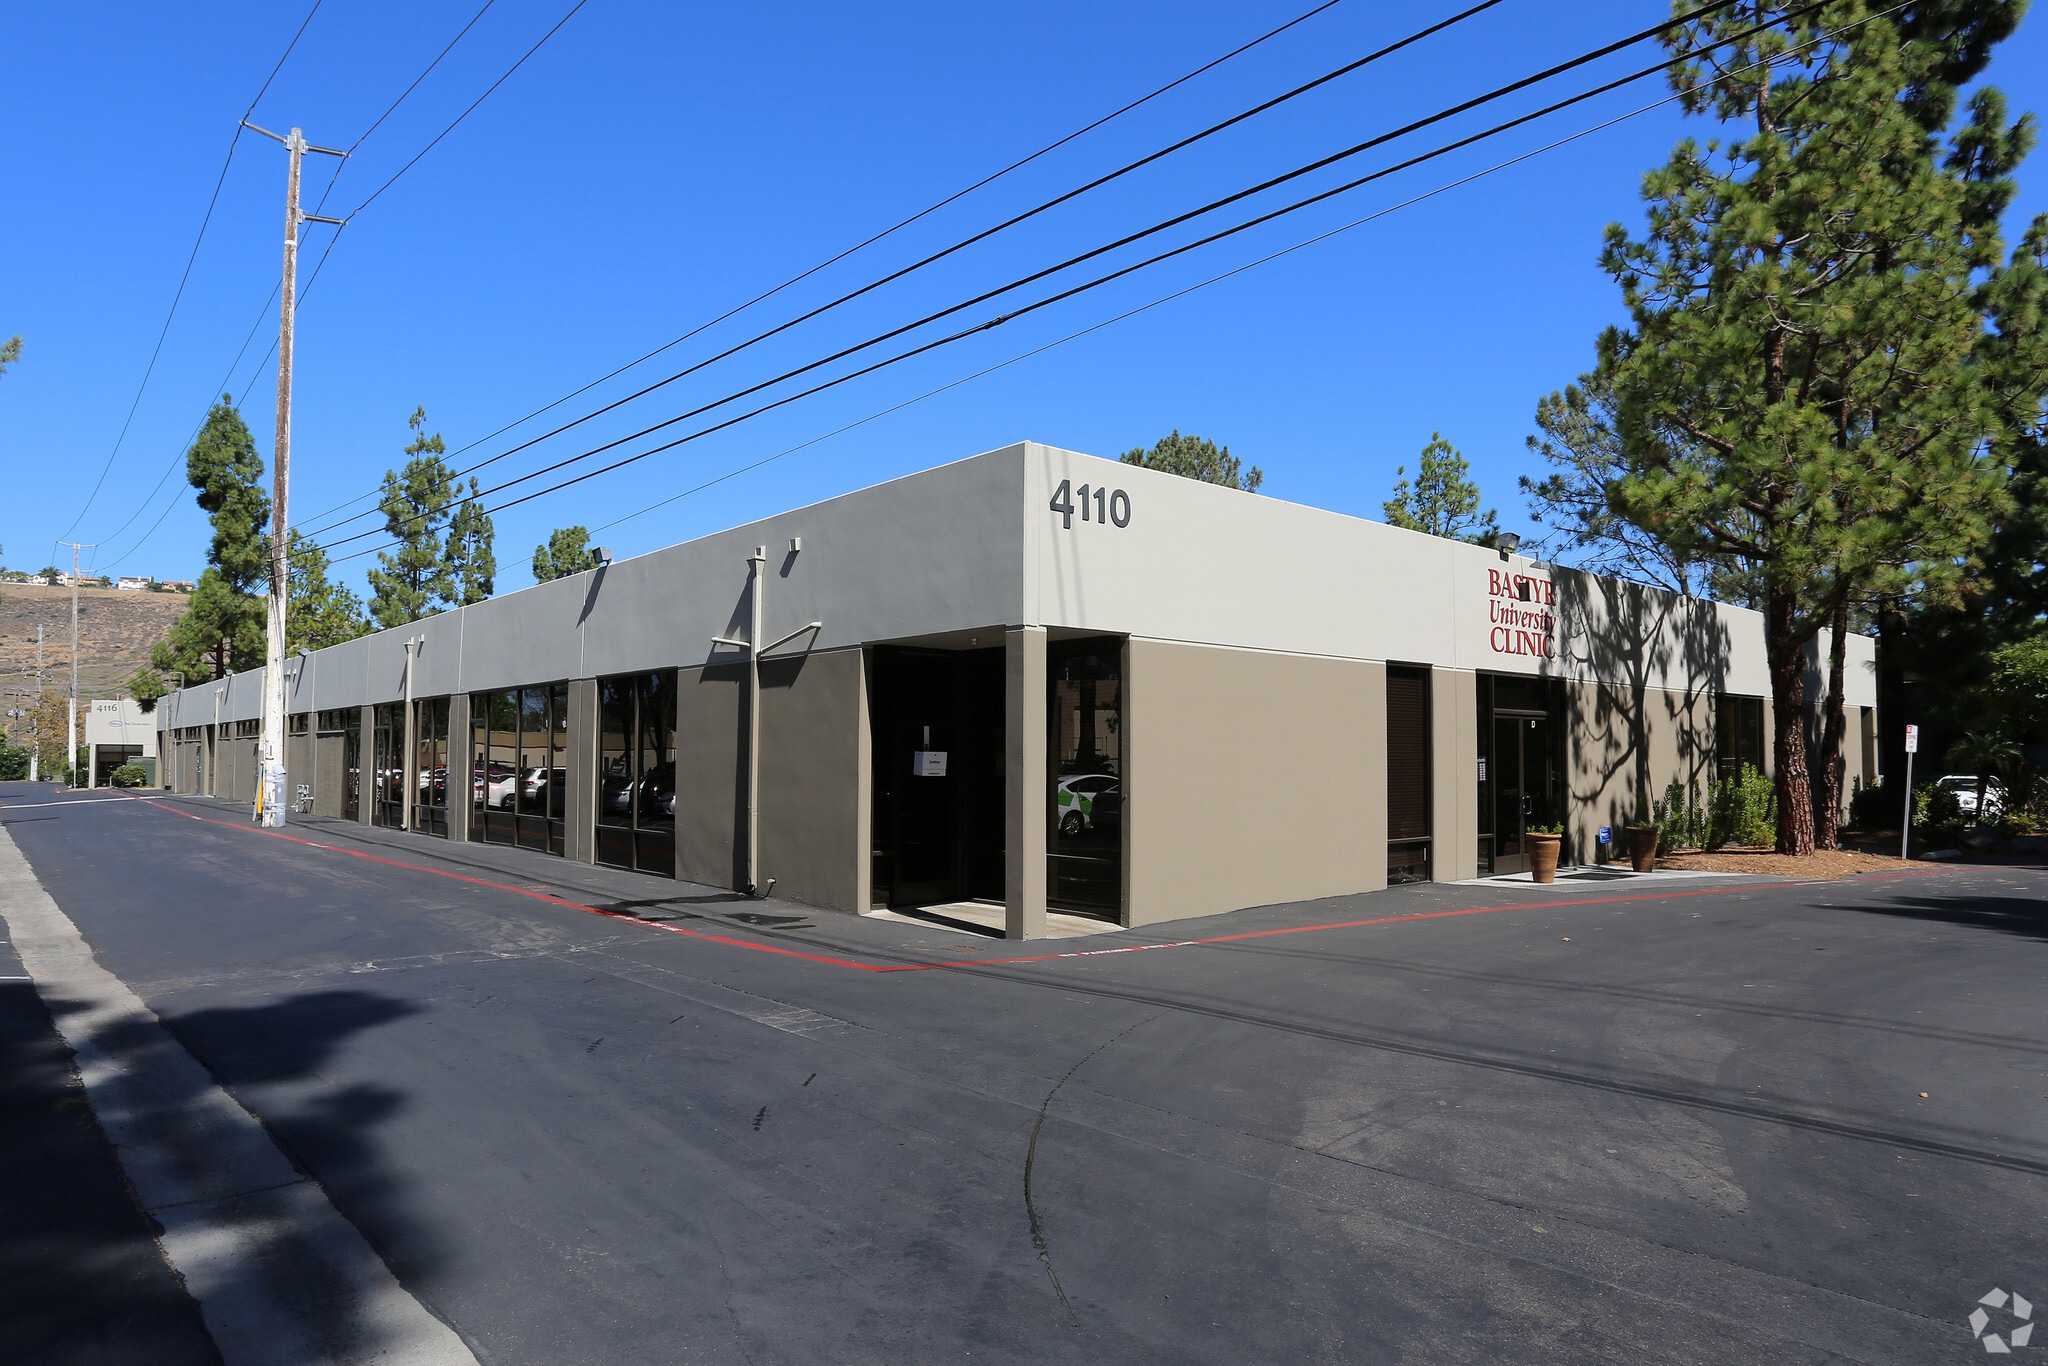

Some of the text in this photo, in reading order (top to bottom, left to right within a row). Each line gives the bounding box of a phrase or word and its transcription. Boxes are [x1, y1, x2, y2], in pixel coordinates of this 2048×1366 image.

[1050, 479, 1131, 529] 4110
[1488, 569, 1556, 606] BASTYR
[1490, 600, 1556, 635] University
[1490, 627, 1556, 659] CLINIC
[96, 703, 118, 712] 4116
